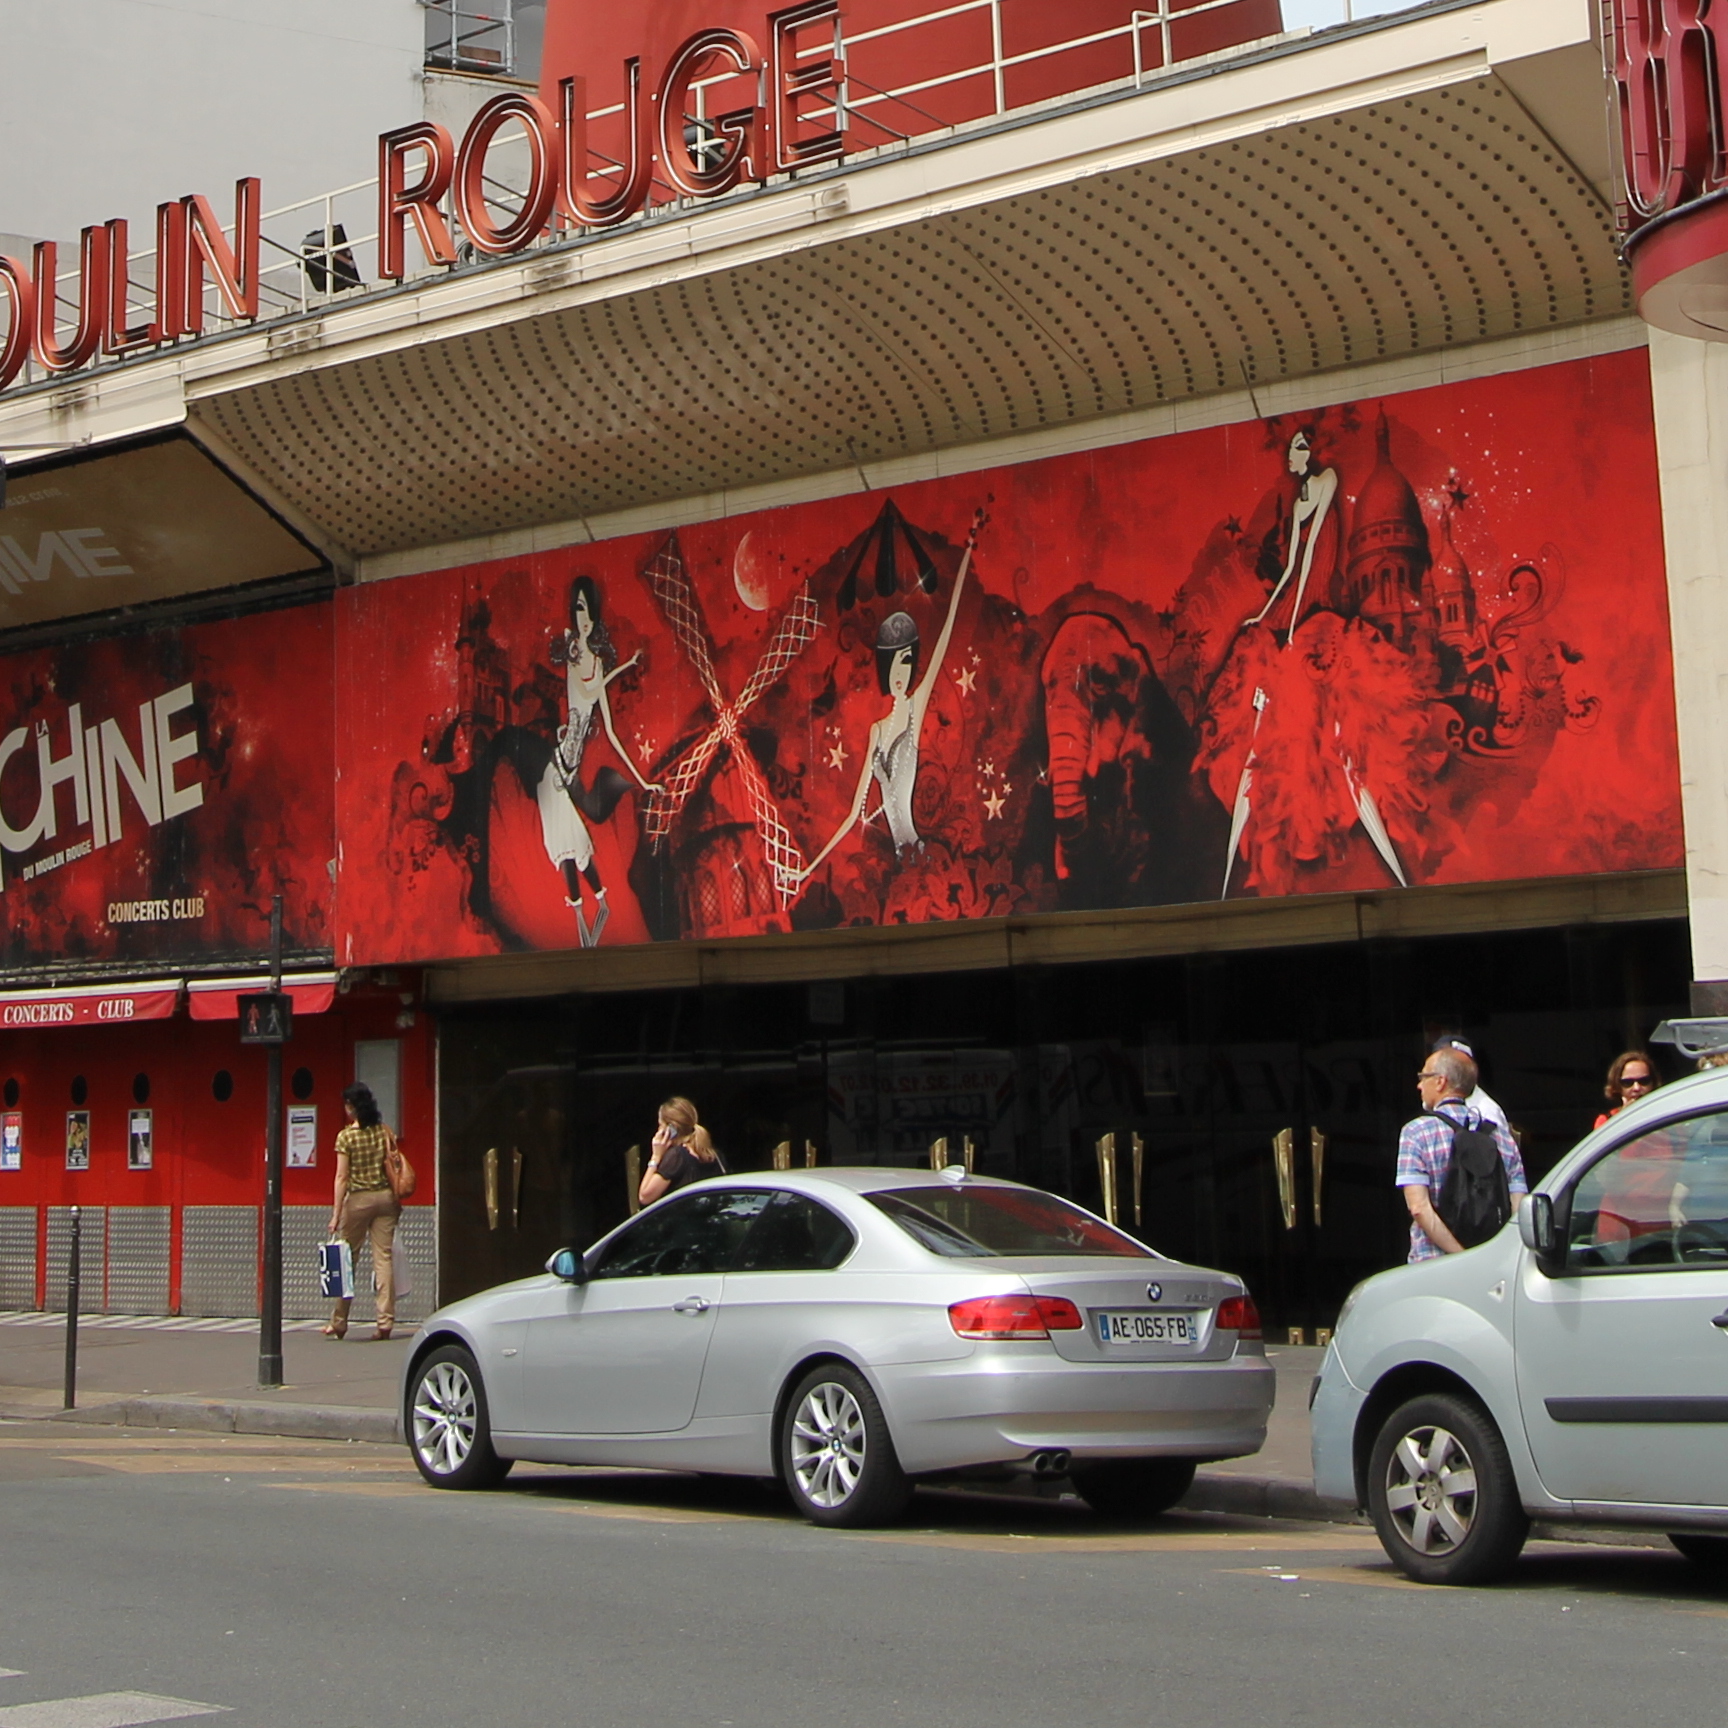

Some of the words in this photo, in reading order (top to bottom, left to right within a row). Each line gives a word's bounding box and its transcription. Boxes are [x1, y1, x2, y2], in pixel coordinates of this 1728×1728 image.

[23, 866, 35, 881] DU
[35, 851, 64, 875] MOULIN
[66, 839, 92, 860] ROUGE
[108, 900, 169, 923] CONCERTS
[173, 897, 205, 919] CLUB
[3, 1003, 74, 1025] CONCERTS
[96, 998, 135, 1020] CLUB
[1112, 1317, 1187, 1338] AE-065-FB
